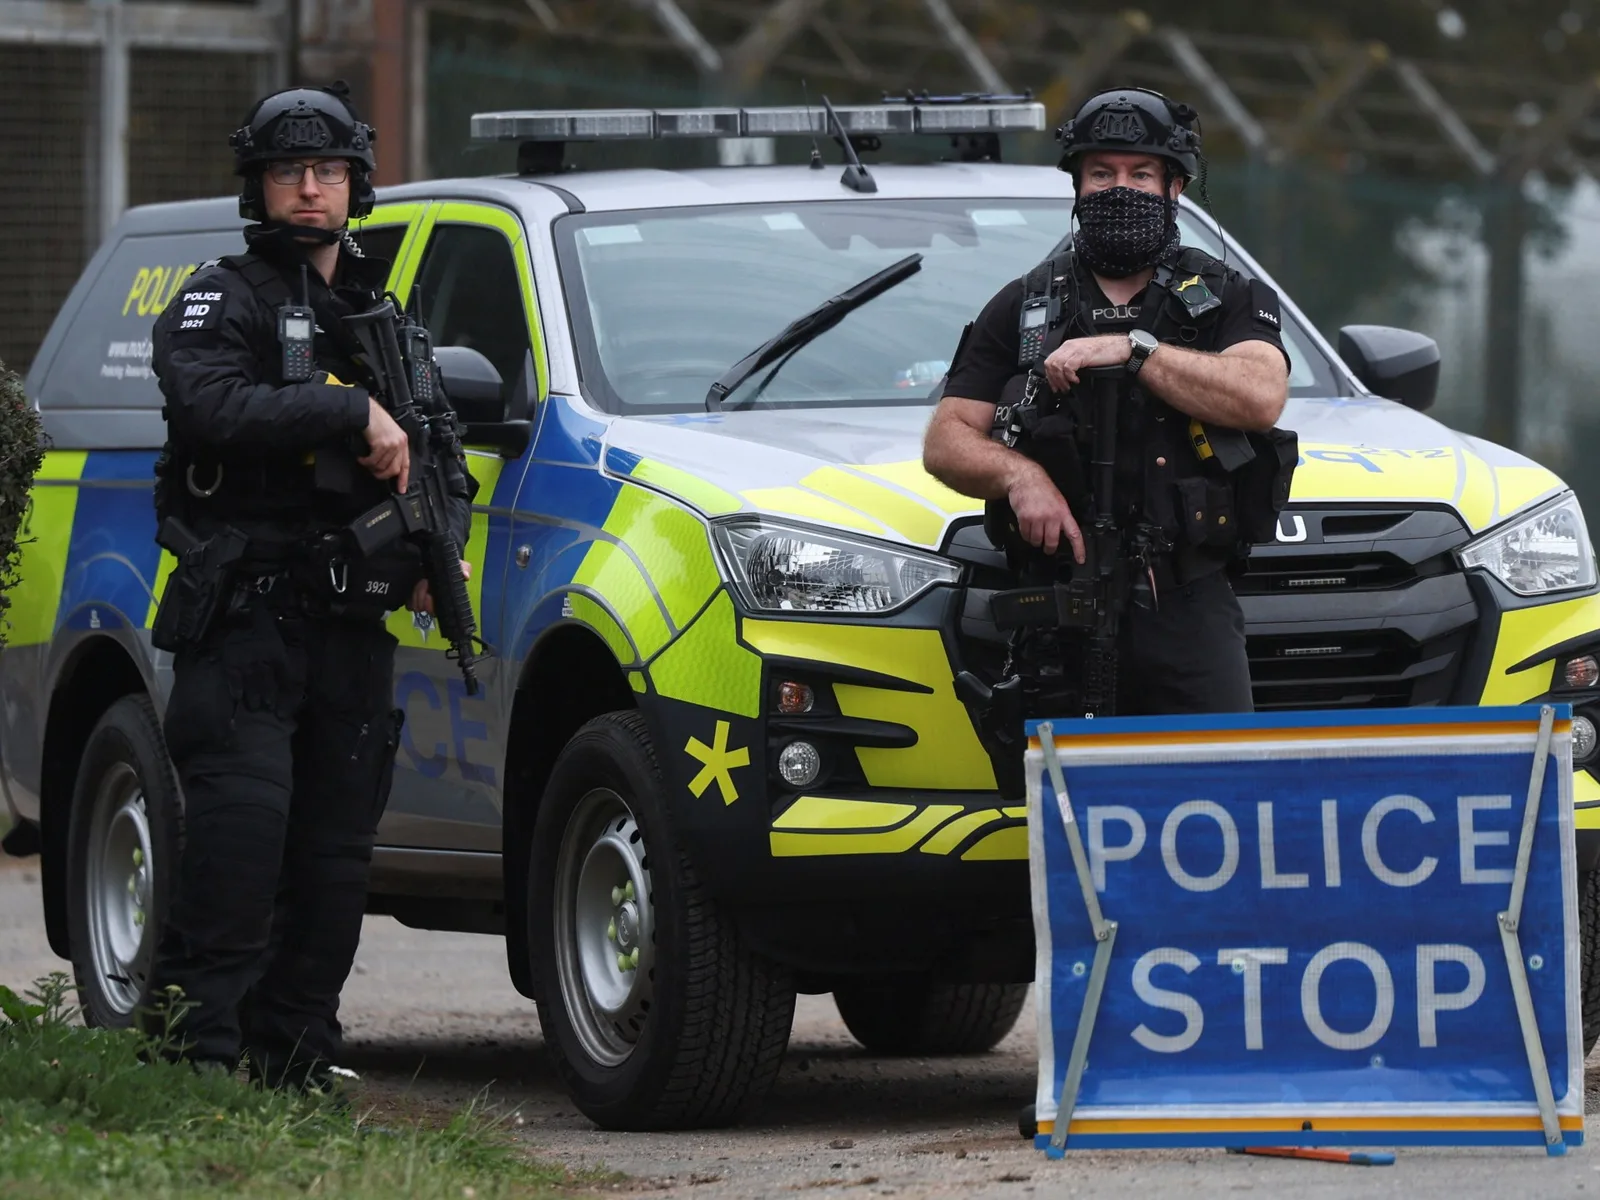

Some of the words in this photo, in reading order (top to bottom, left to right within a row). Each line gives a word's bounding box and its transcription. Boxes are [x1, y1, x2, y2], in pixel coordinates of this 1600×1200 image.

[183, 292, 222, 301] POLICE
[184, 304, 210, 317] MD
[1092, 306, 1142, 320] POLIC
[180, 319, 204, 329] 3921
[365, 580, 390, 595] 3921
[1086, 794, 1515, 893] POLICE
[1129, 941, 1487, 1054] STOP
